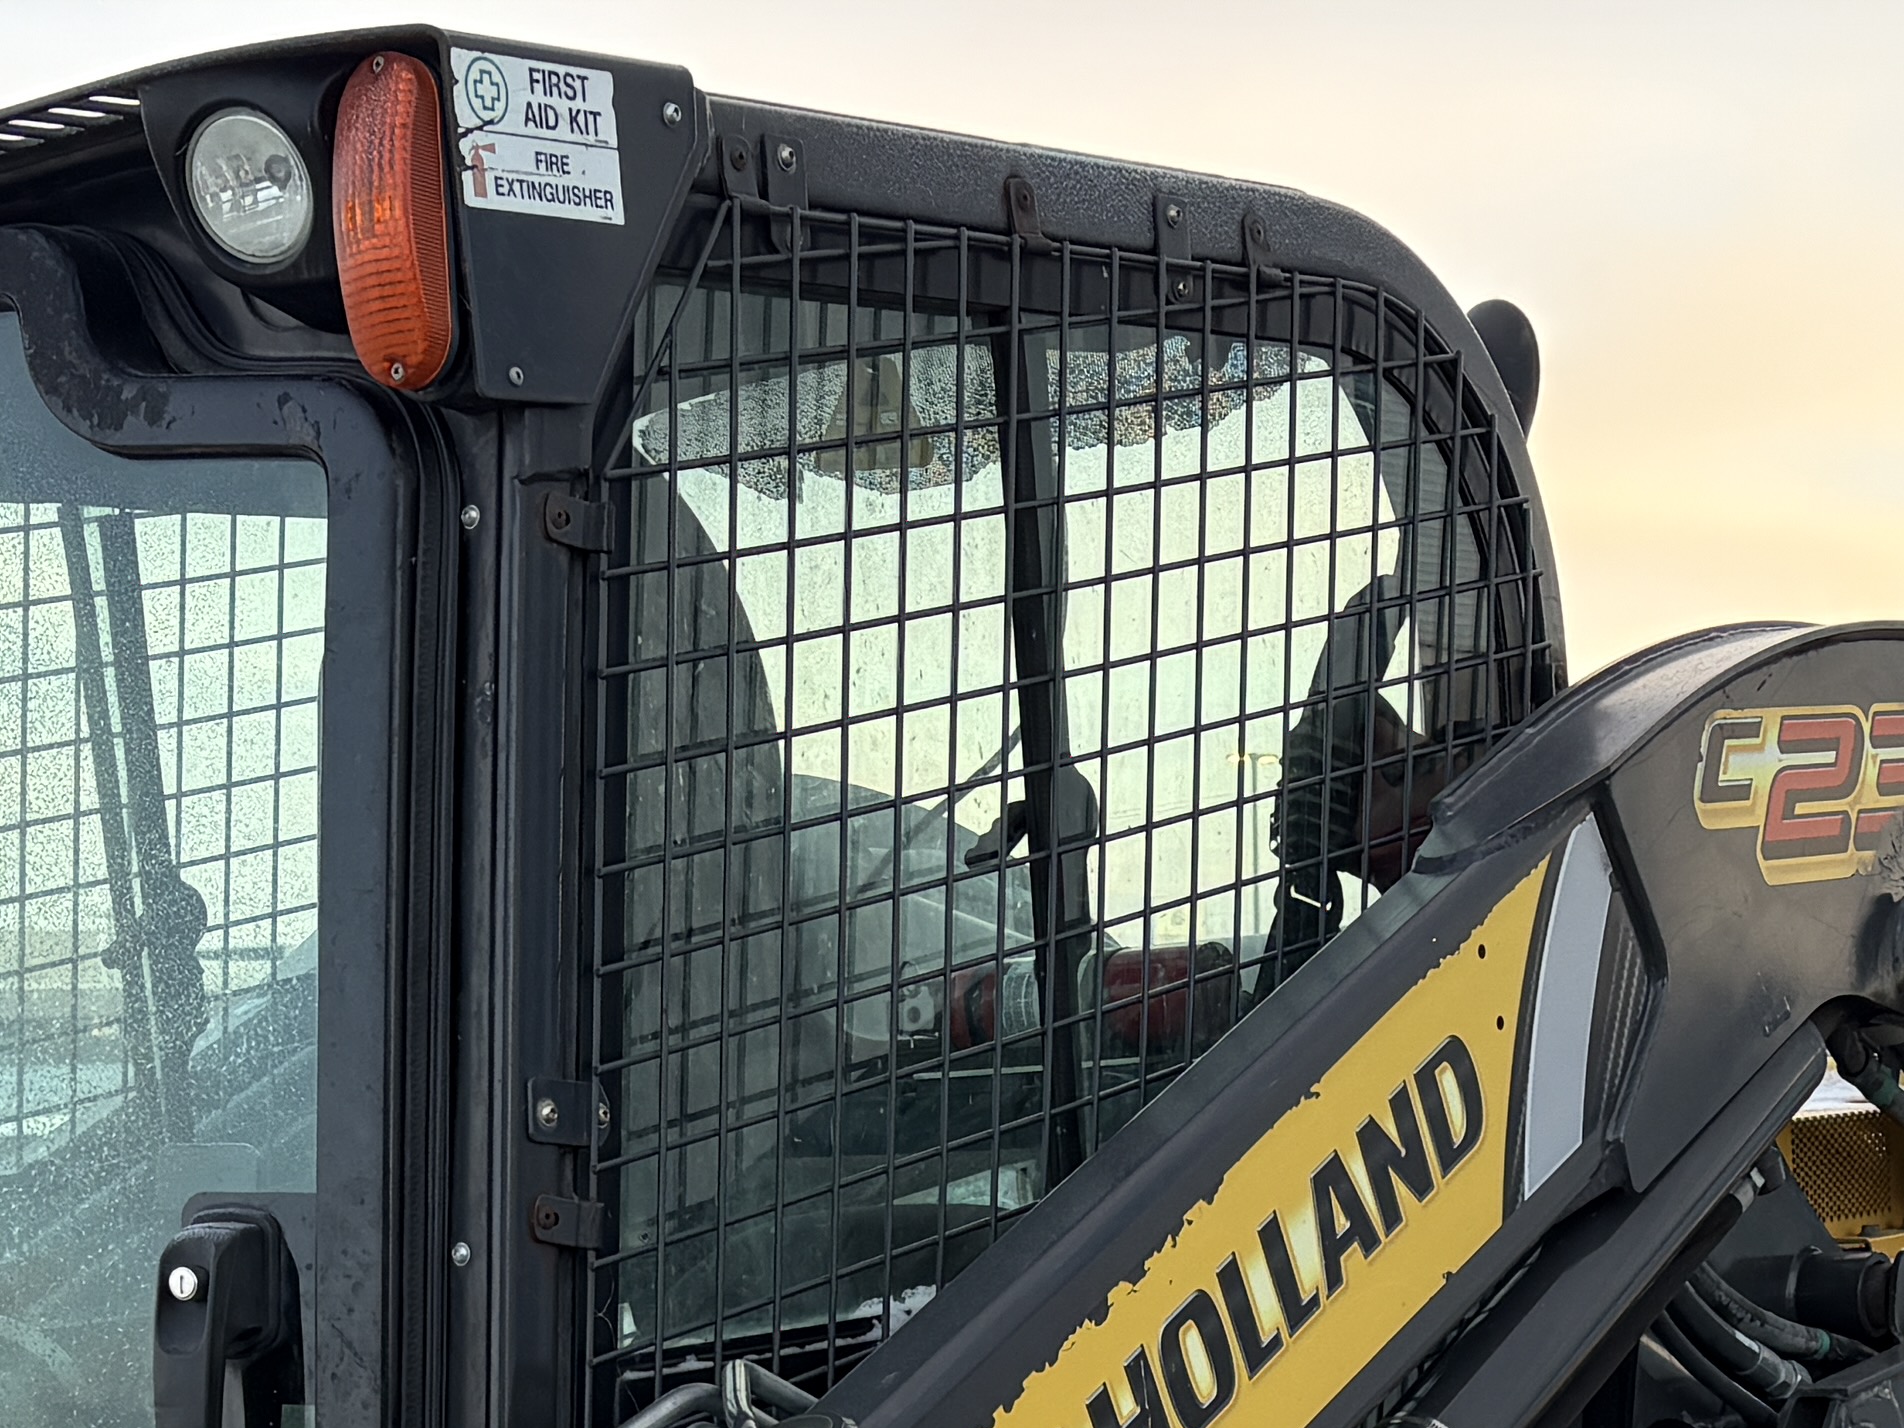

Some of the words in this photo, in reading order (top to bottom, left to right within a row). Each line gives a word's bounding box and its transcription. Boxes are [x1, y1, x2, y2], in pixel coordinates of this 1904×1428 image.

[528, 66, 589, 103] FIRST
[524, 101, 559, 131] AID
[568, 110, 602, 138] KIT
[534, 151, 571, 175] FIRE
[494, 176, 614, 211] EXTINGUISHER
